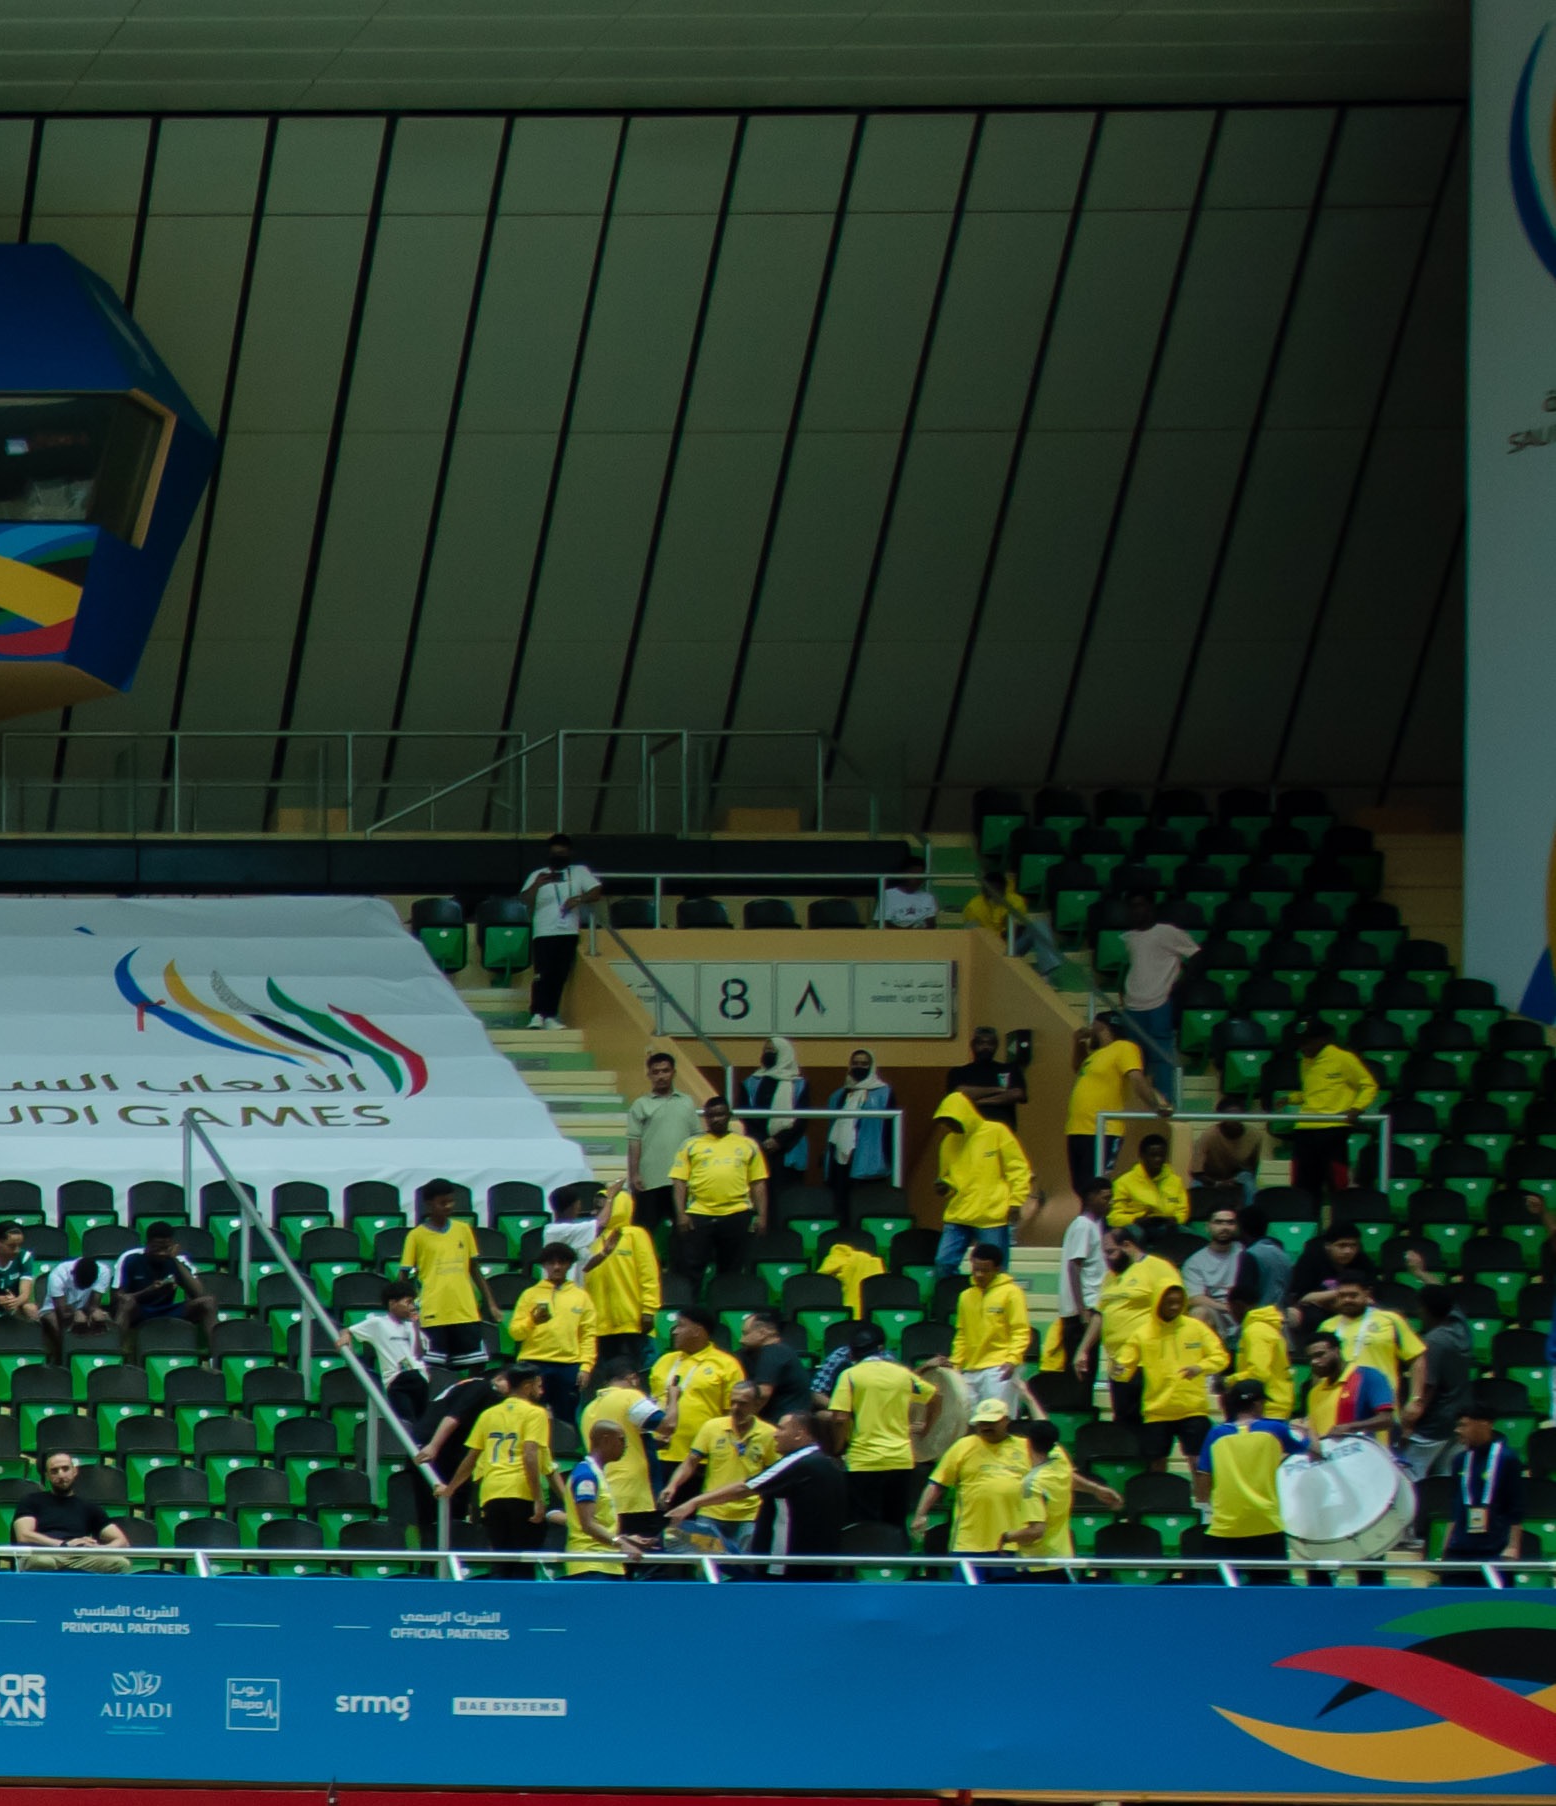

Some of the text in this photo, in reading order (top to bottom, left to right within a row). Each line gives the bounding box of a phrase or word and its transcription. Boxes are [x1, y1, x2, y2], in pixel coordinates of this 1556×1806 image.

[719, 979, 750, 1019] 8
[796, 981, 825, 1016] ٨
[118, 1105, 391, 1127] GAMES
[489, 1432, 518, 1463] 77
[134, 1604, 180, 1621] الشريك
[454, 1610, 501, 1626] الشريك
[61, 1621, 190, 1635] PRINCIPAL PARTNERS
[390, 1627, 510, 1640] OFFICIAL PARTNERS
[99, 1702, 174, 1721] ALJADI
[335, 1688, 414, 1722] srmg
[459, 1701, 560, 1712] BAE SYSTEMS
